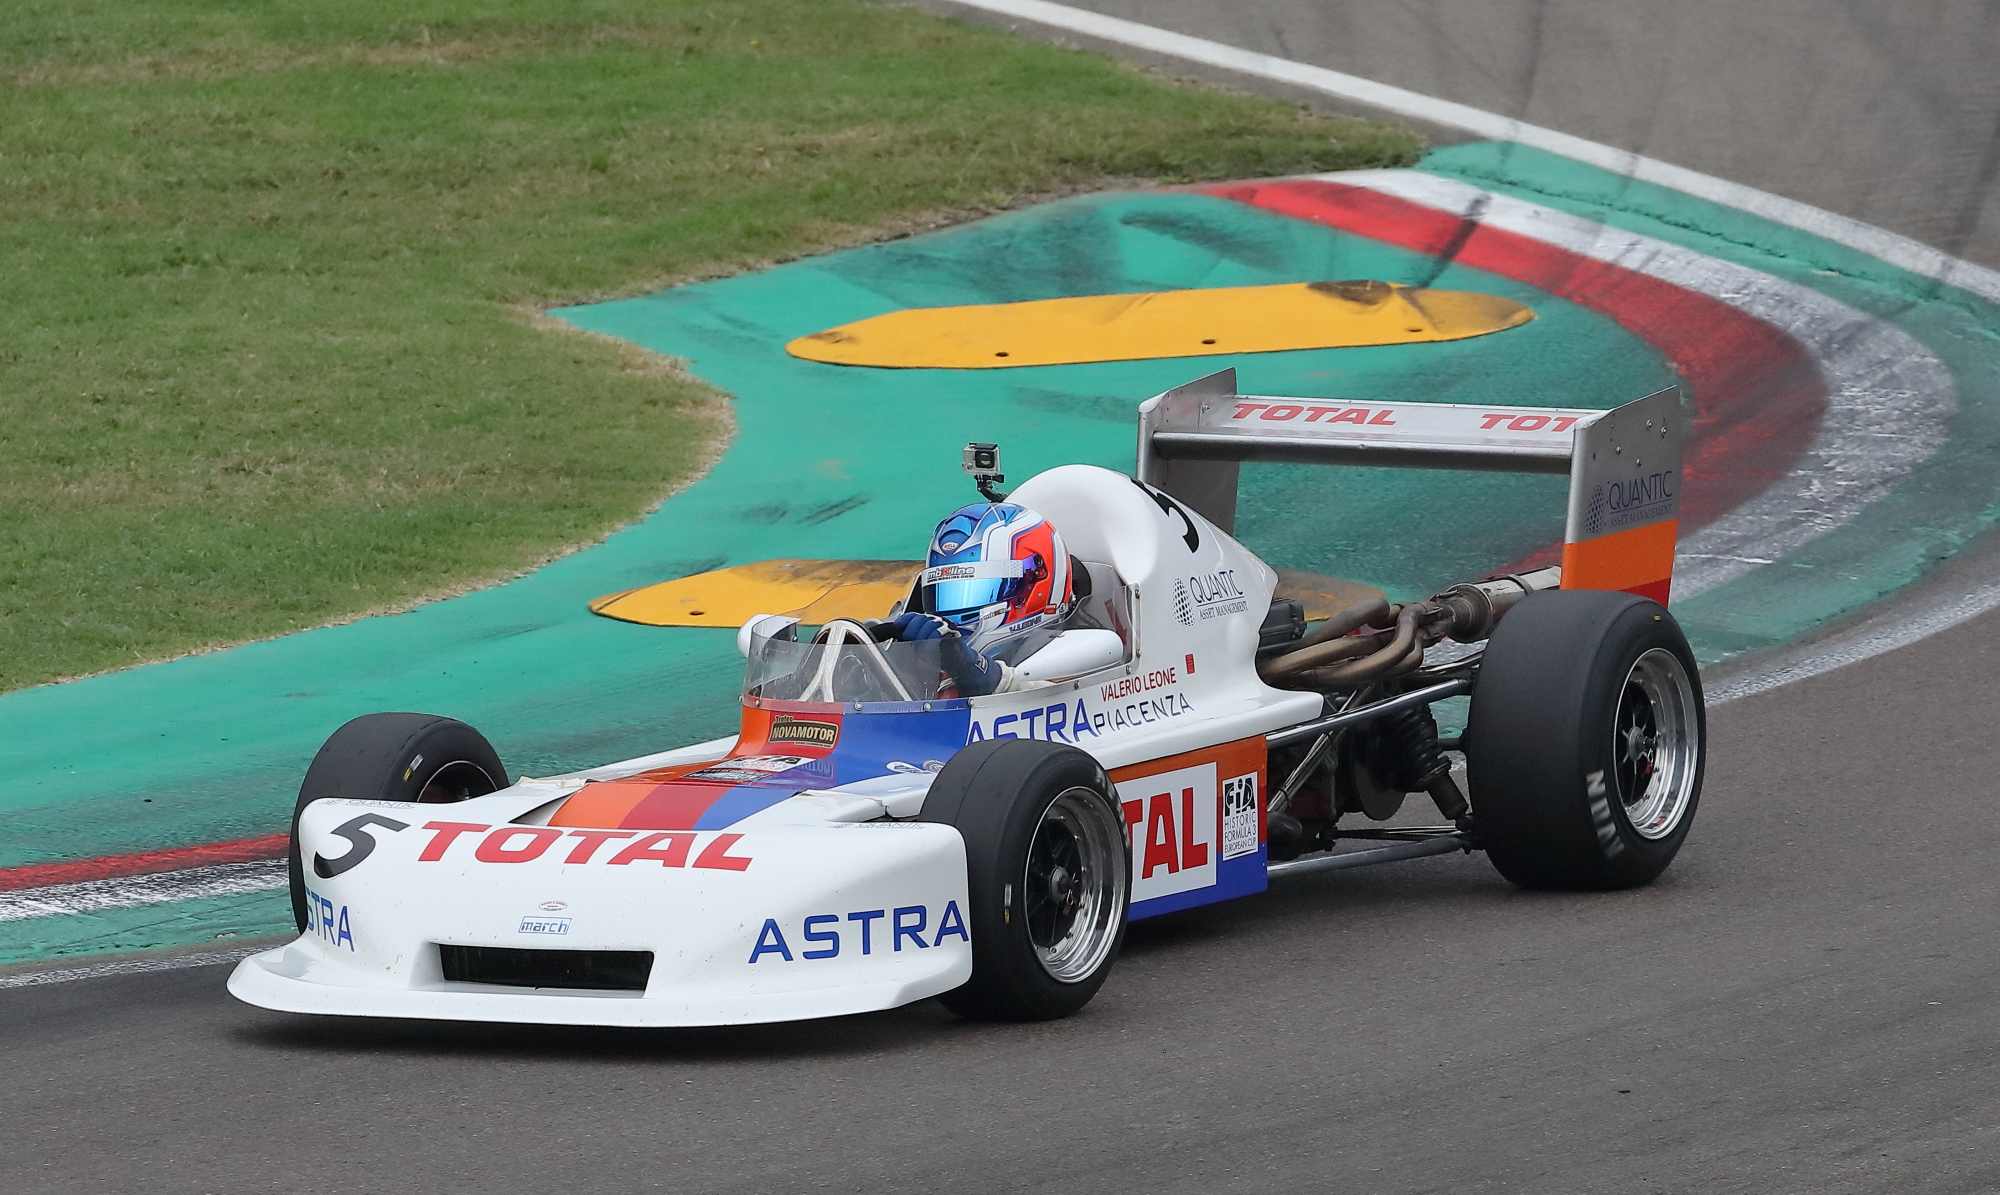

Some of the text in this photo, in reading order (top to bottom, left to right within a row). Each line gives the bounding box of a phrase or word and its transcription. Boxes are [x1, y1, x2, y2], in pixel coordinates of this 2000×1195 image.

[1232, 403, 1397, 425] TOTAL
[1479, 413, 1580, 432] TOT
[1609, 470, 1672, 510] QUANTIC
[1190, 569, 1244, 603] QUANTIC
[1200, 601, 1248, 620] ASSET MANAGEMENT
[1101, 667, 1177, 702] VALERIO LEONE
[965, 692, 1195, 746] ASTRA PIACENZA
[772, 726, 835, 742] NOVAMOTOR
[1225, 811, 1256, 830] HISTORIC
[1225, 824, 1257, 843] FORMULA 3
[313, 813, 754, 879] 5 TOTAL
[1225, 837, 1257, 853] EUROPEAN CUP
[521, 920, 568, 932] march
[748, 900, 969, 964] ASTRA
